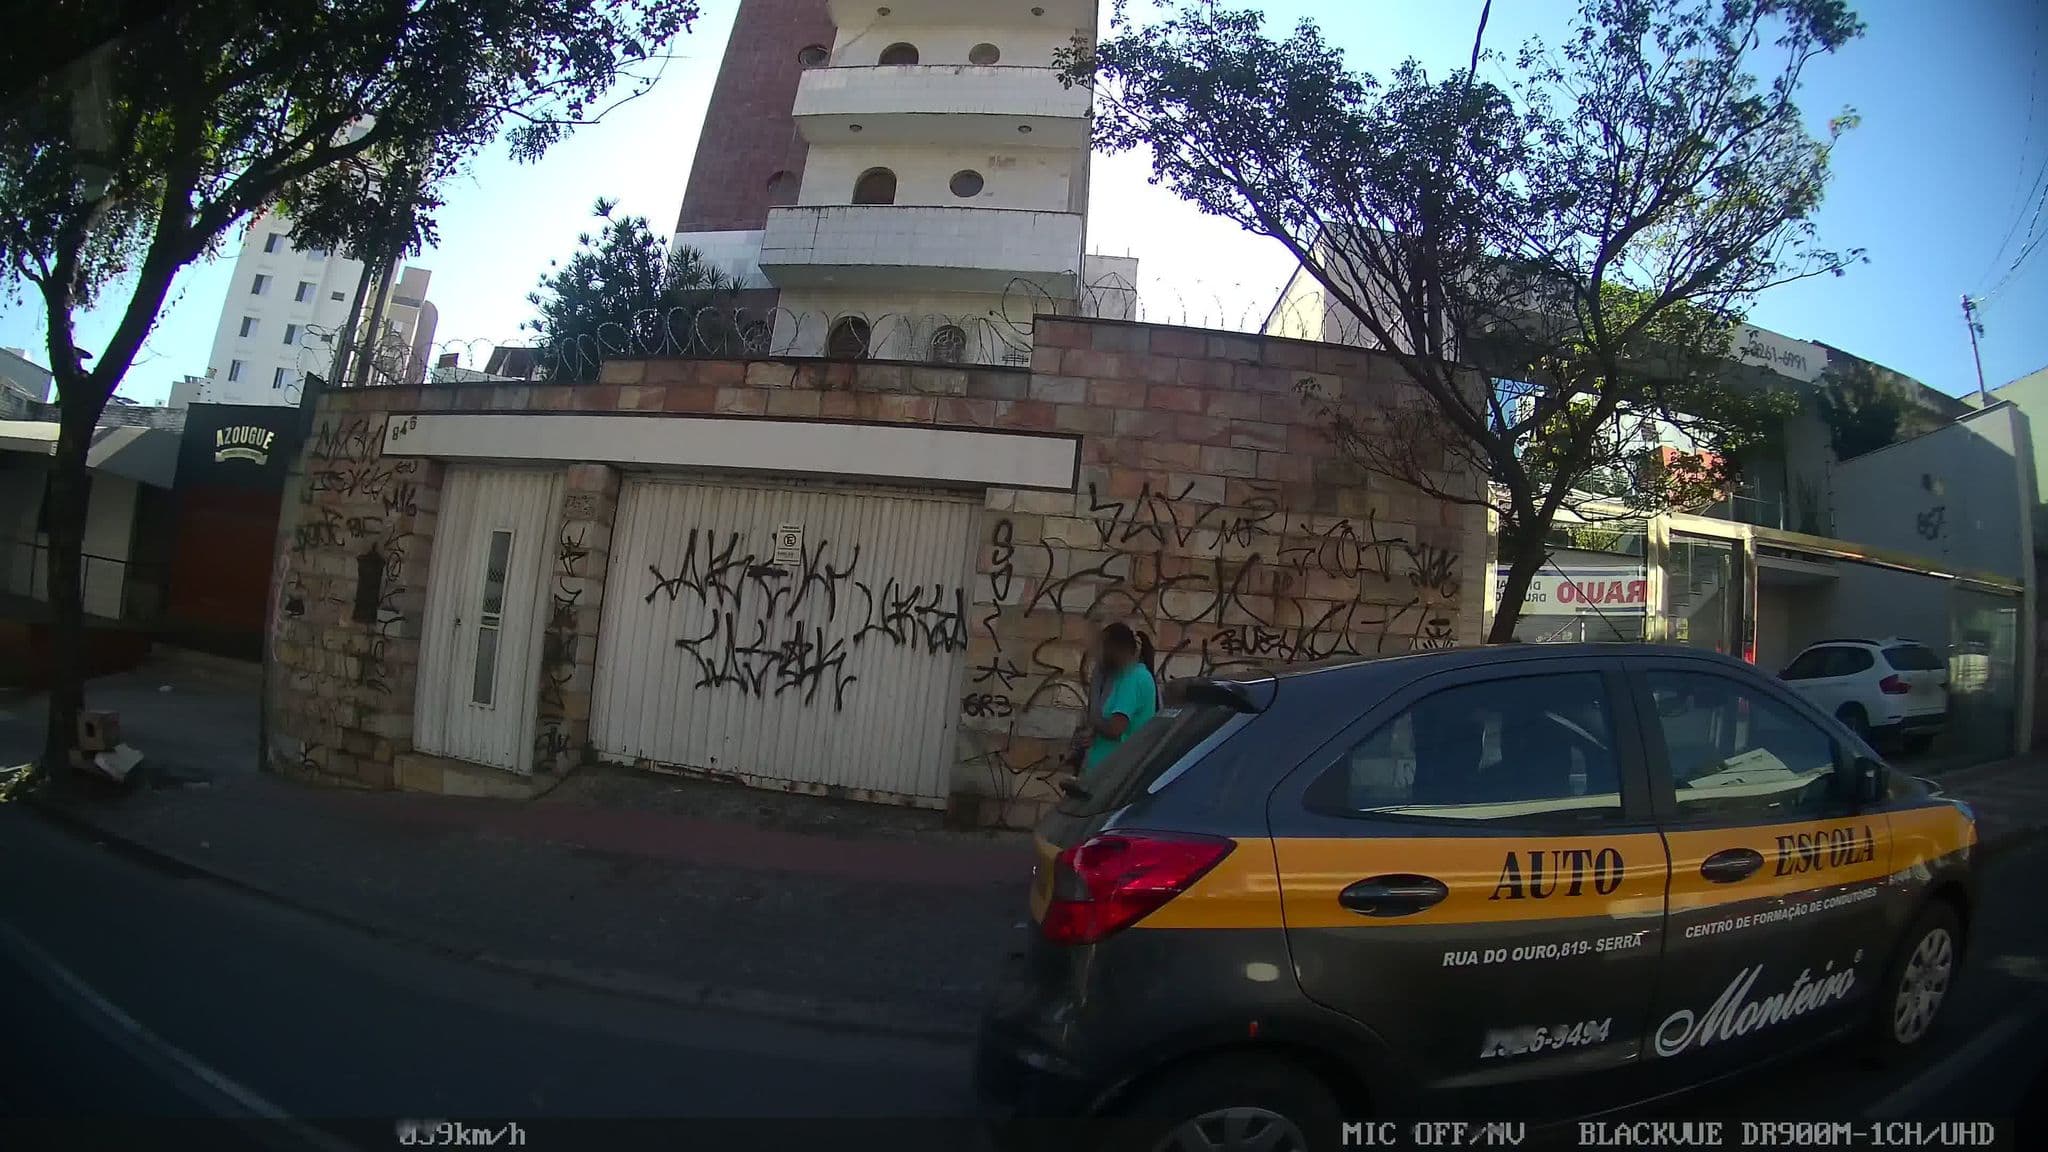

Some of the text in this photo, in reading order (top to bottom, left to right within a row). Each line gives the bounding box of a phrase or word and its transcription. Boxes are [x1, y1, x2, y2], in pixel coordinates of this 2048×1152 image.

[216, 426, 275, 450] AZOUGUE
[1489, 848, 1624, 900] AUTO
[1773, 825, 1874, 877] ESCOLA
[1685, 886, 1879, 939] CENTRO DE FORMAÇÃO DE CONDUTORES
[1442, 950, 1479, 967] RUA
[1483, 948, 1508, 964] DO
[1596, 934, 1642, 952] SERRA
[1654, 963, 1856, 1057] Monteiro
